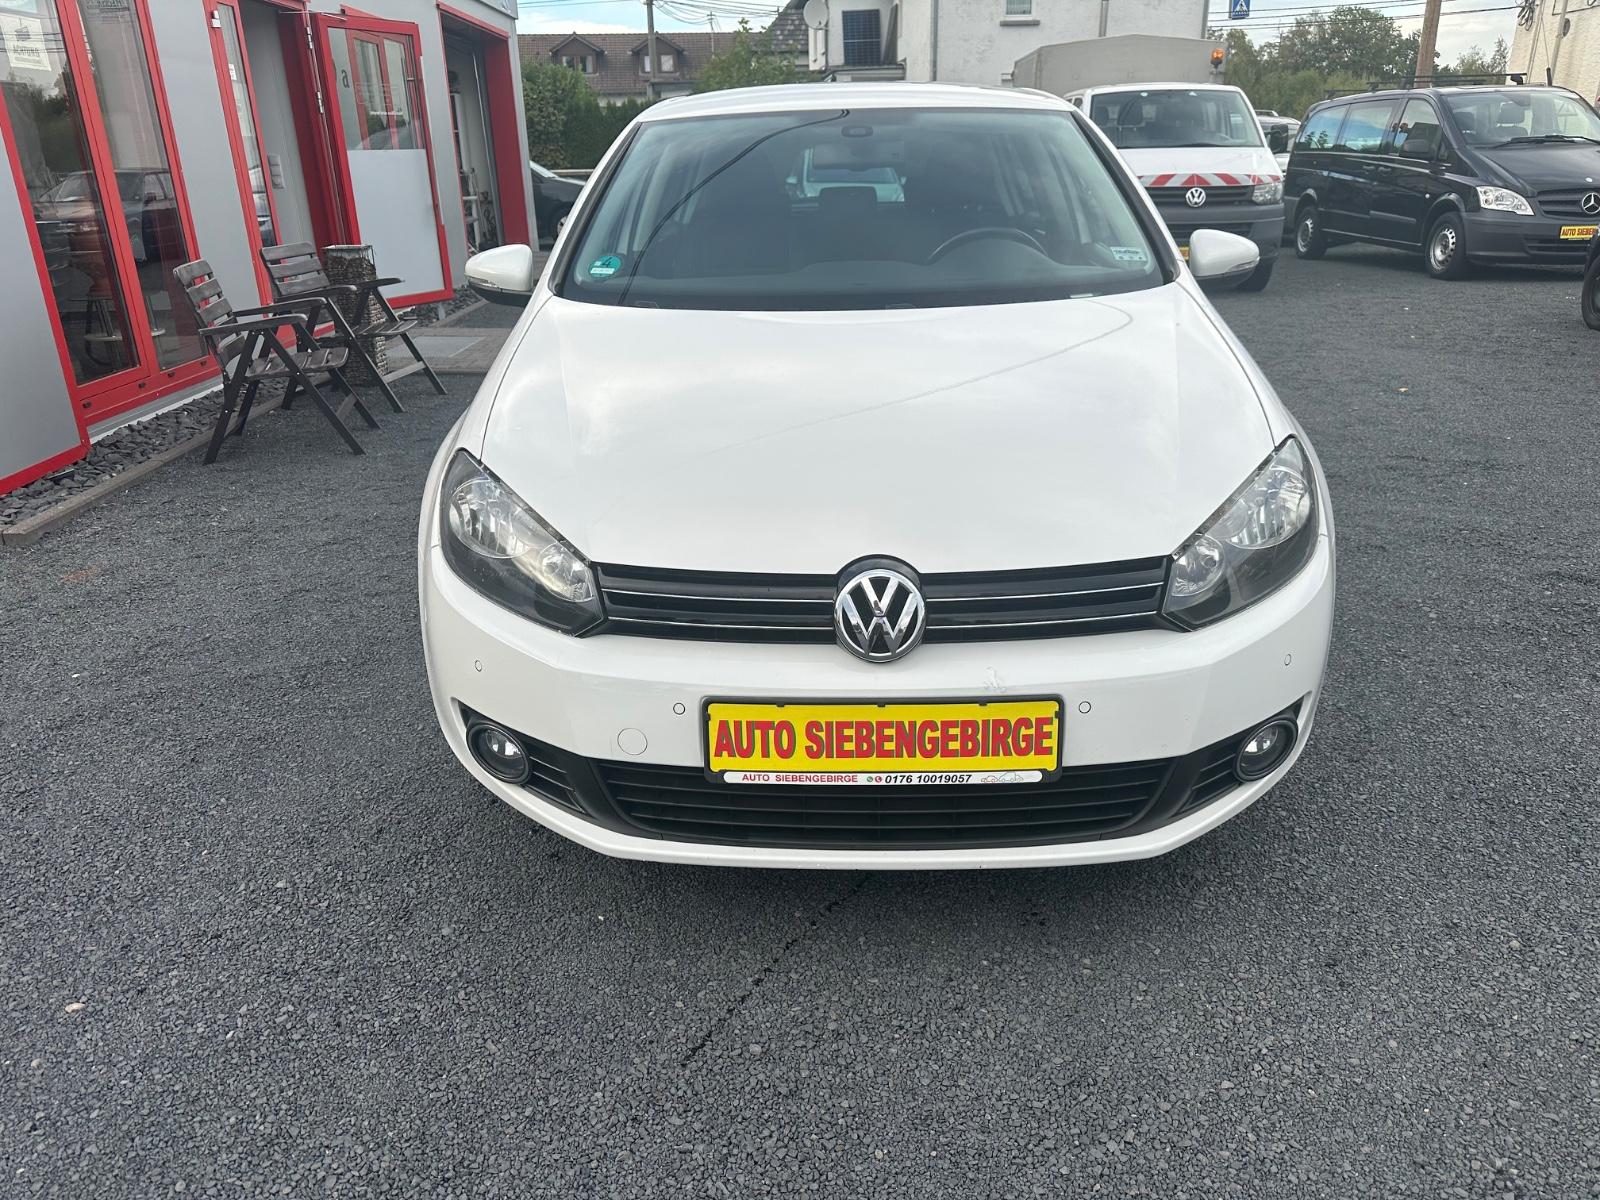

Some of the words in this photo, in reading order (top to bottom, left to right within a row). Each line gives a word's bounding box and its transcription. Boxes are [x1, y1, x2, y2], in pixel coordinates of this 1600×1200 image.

[1562, 227, 1577, 237] AUTO
[601, 256, 613, 268] 4
[835, 568, 925, 662] VW
[714, 719, 797, 760] AUTO
[804, 716, 1054, 760] SIEBENGEBIRGE
[742, 773, 770, 782] AUTO
[775, 774, 858, 783] SIEBENGEBIRGE
[885, 774, 913, 784] 0176
[916, 774, 972, 784] 10019057
